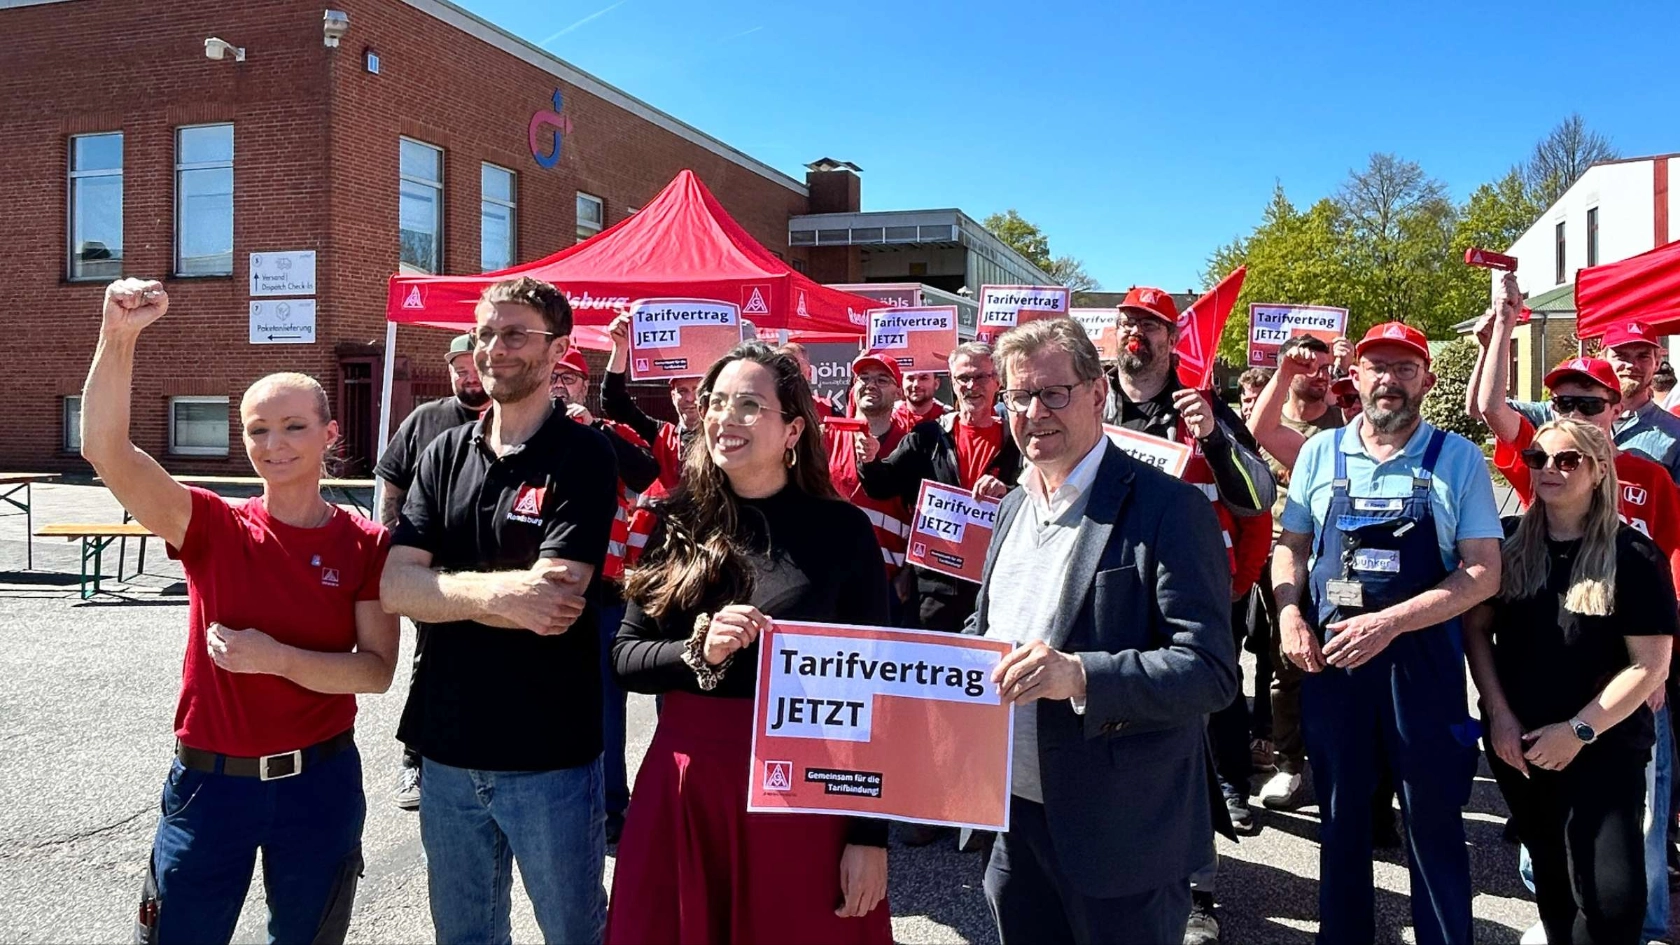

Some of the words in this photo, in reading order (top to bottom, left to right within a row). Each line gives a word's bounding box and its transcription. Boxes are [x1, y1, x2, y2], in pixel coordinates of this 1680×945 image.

[261, 283, 286, 292] Dispatch
[987, 294, 1059, 309] Tarifvertrag
[636, 309, 729, 323] Tarifvertrag
[873, 317, 947, 328] Tarifvertrag
[983, 311, 1015, 323] JETZT
[1258, 313, 1335, 328] Tarifvertrag
[257, 323, 312, 333] Paketanlieferung
[1255, 329, 1288, 340] JETZT
[636, 330, 676, 346] JETZT
[872, 334, 905, 347] JETZT
[927, 494, 996, 523] Tarifvert
[919, 515, 962, 536] JETZT
[780, 649, 984, 697] Tarifvertrag
[771, 697, 865, 730] JETZT
[808, 771, 853, 782] Gemeinsam
[854, 774, 867, 782] für
[867, 775, 880, 784] die
[828, 784, 879, 796] Tarifbindung!
